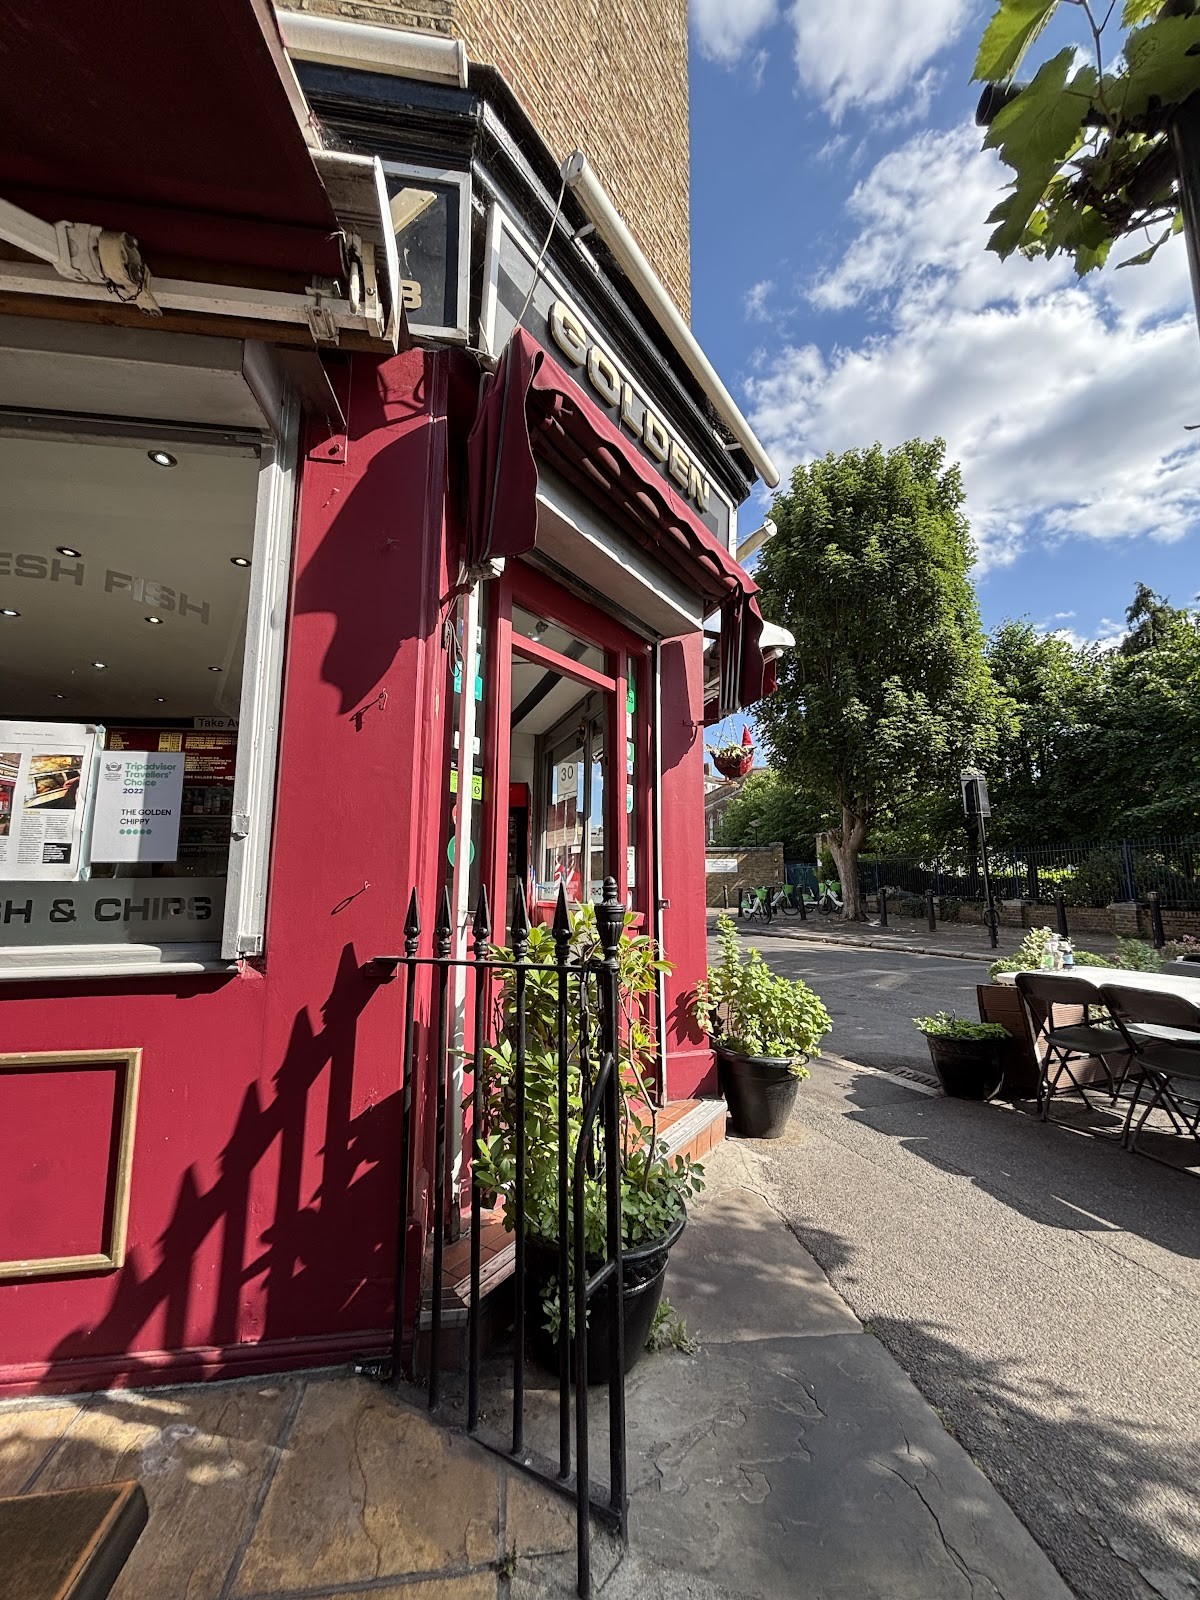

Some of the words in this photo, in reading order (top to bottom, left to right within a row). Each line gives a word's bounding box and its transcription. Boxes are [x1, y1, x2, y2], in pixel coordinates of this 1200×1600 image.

[549, 299, 711, 513] GOLDEN
[104, 569, 210, 626] FISH
[198, 718, 224, 728] Take
[125, 762, 177, 771] Tripadvisor
[561, 765, 574, 782] 30
[124, 778, 157, 787] Choice
[121, 808, 137, 816] THE
[138, 808, 172, 816] GOLDEN
[49, 898, 77, 922] &
[94, 896, 212, 922] CHIPS
